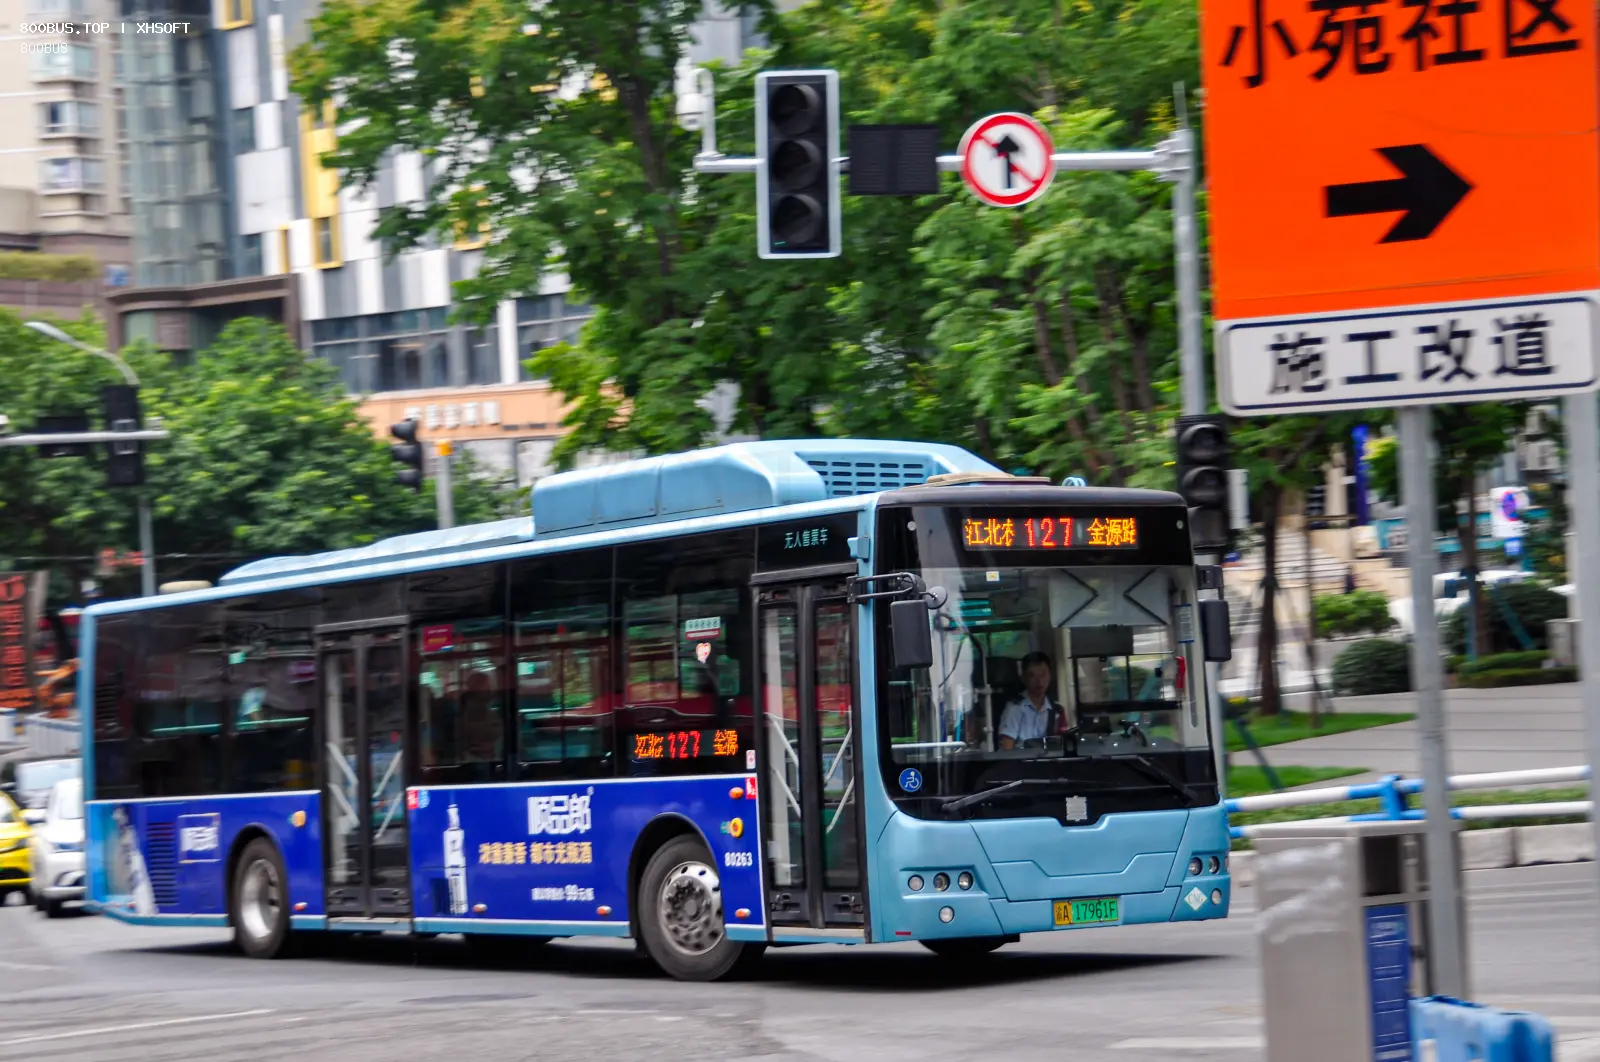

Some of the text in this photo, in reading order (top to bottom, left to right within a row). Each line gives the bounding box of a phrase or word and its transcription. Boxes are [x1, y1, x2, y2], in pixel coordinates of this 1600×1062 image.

[1219, 0, 1582, 89] 小苑社区
[1264, 311, 1558, 395] 施工改道
[1024, 518, 1073, 547] 127
[667, 730, 701, 759] 127
[724, 851, 753, 867] 80263
